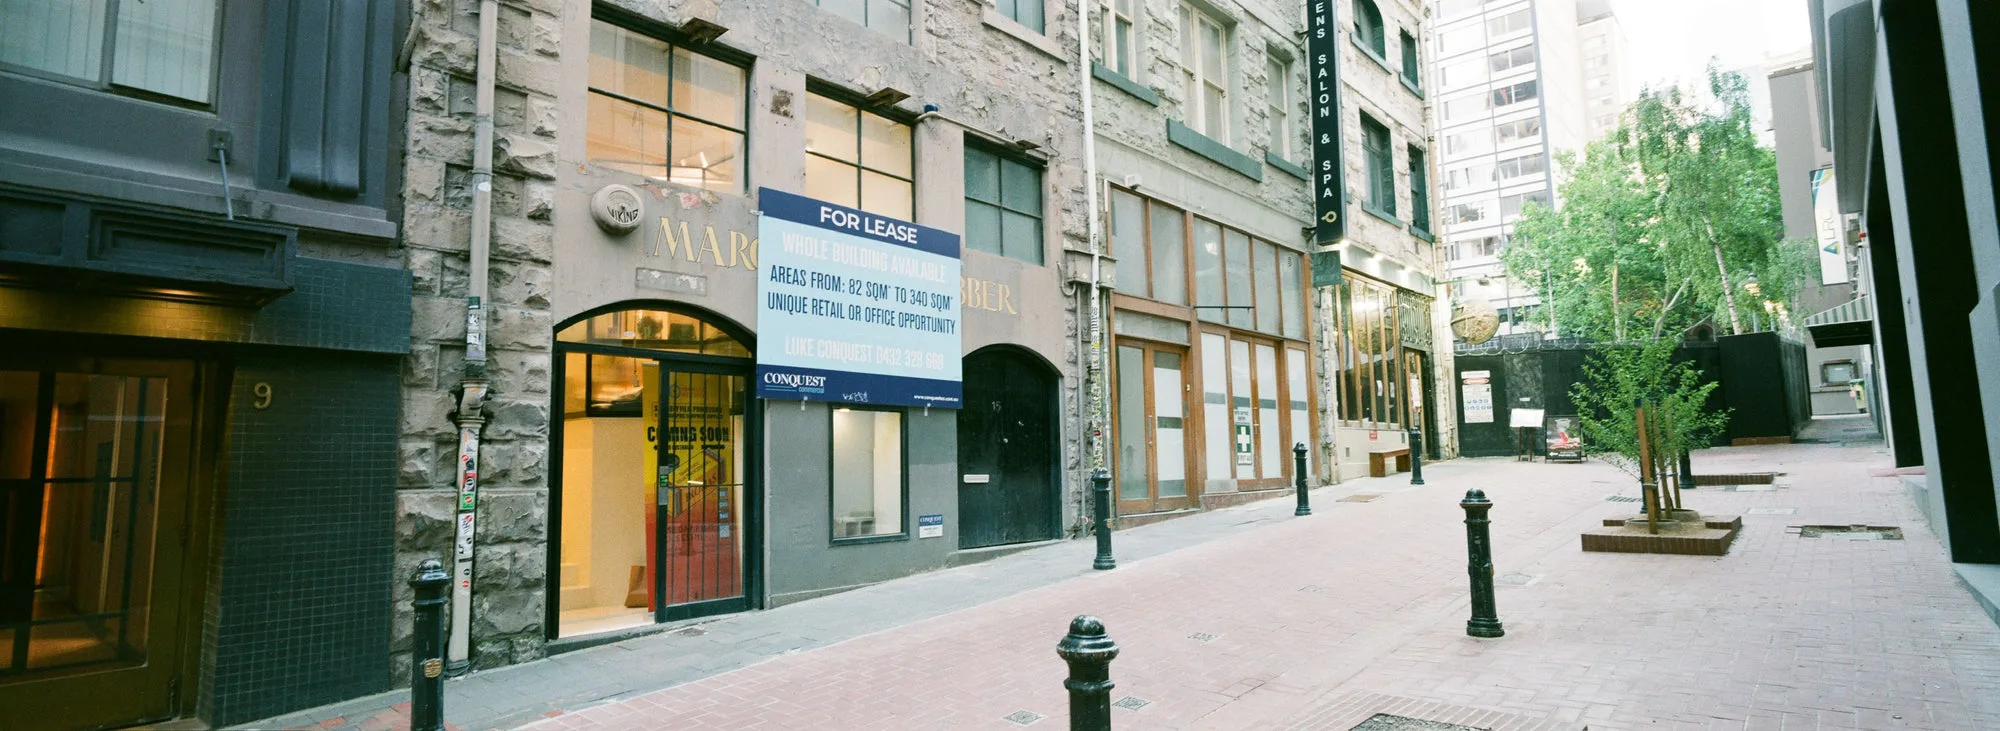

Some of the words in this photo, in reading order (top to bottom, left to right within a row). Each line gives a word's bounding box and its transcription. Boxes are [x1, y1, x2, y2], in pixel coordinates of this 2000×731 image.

[1315, 0, 1325, 38] ENS
[1318, 54, 1330, 117] SALON
[1321, 134, 1331, 144] &
[1322, 160, 1333, 198] SPA
[607, 205, 639, 223] VIKING
[820, 206, 859, 230] FOR
[865, 217, 918, 244] LEASE
[782, 232, 828, 260] WHOLE
[833, 242, 888, 272] BUILDING
[891, 255, 946, 284] AVAILABLE
[770, 265, 806, 287] AREAS
[811, 272, 845, 294] FROM:
[849, 279, 862, 296] 82
[895, 286, 907, 303] TO
[910, 289, 927, 307] 340
[767, 292, 807, 315] UNIQUE
[812, 298, 845, 320] RETAIL
[848, 304, 861, 322] OR
[865, 307, 895, 327] OFFICE
[898, 312, 956, 335] OPPORTUNITY
[785, 336, 814, 357] LUKE
[817, 339, 874, 363] CONQUEST
[876, 345, 901, 366] 0432
[254, 382, 272, 409] 9
[764, 372, 826, 387] CONQUEST
[647, 426, 697, 442] CMING
